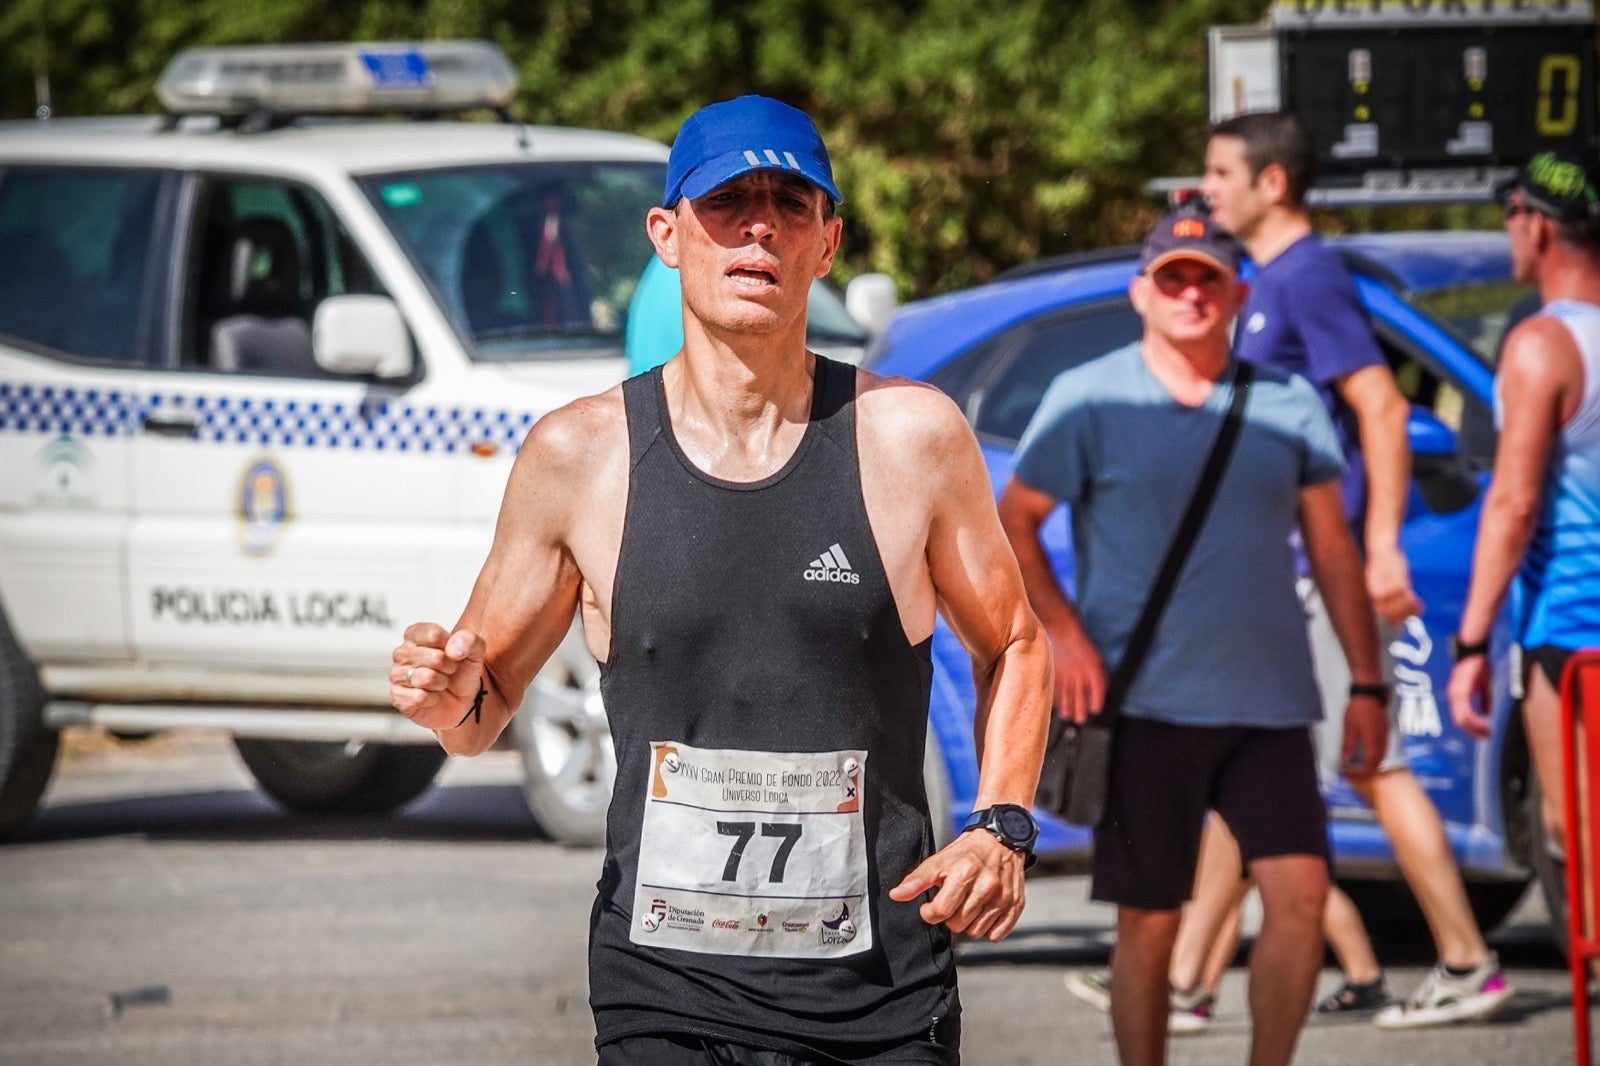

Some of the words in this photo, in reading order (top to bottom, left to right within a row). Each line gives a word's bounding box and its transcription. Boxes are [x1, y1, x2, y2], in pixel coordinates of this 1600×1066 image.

[803, 566, 861, 585] adidas
[291, 588, 394, 628] LOCAL
[701, 767, 725, 784] GRAN
[728, 767, 763, 786] PREMIO
[782, 770, 812, 787] FONDO
[815, 770, 842, 787] 2022
[722, 787, 761, 802] UNIVERSO
[716, 821, 803, 884] 77
[668, 905, 705, 917] Diputación
[676, 915, 705, 925] Granada
